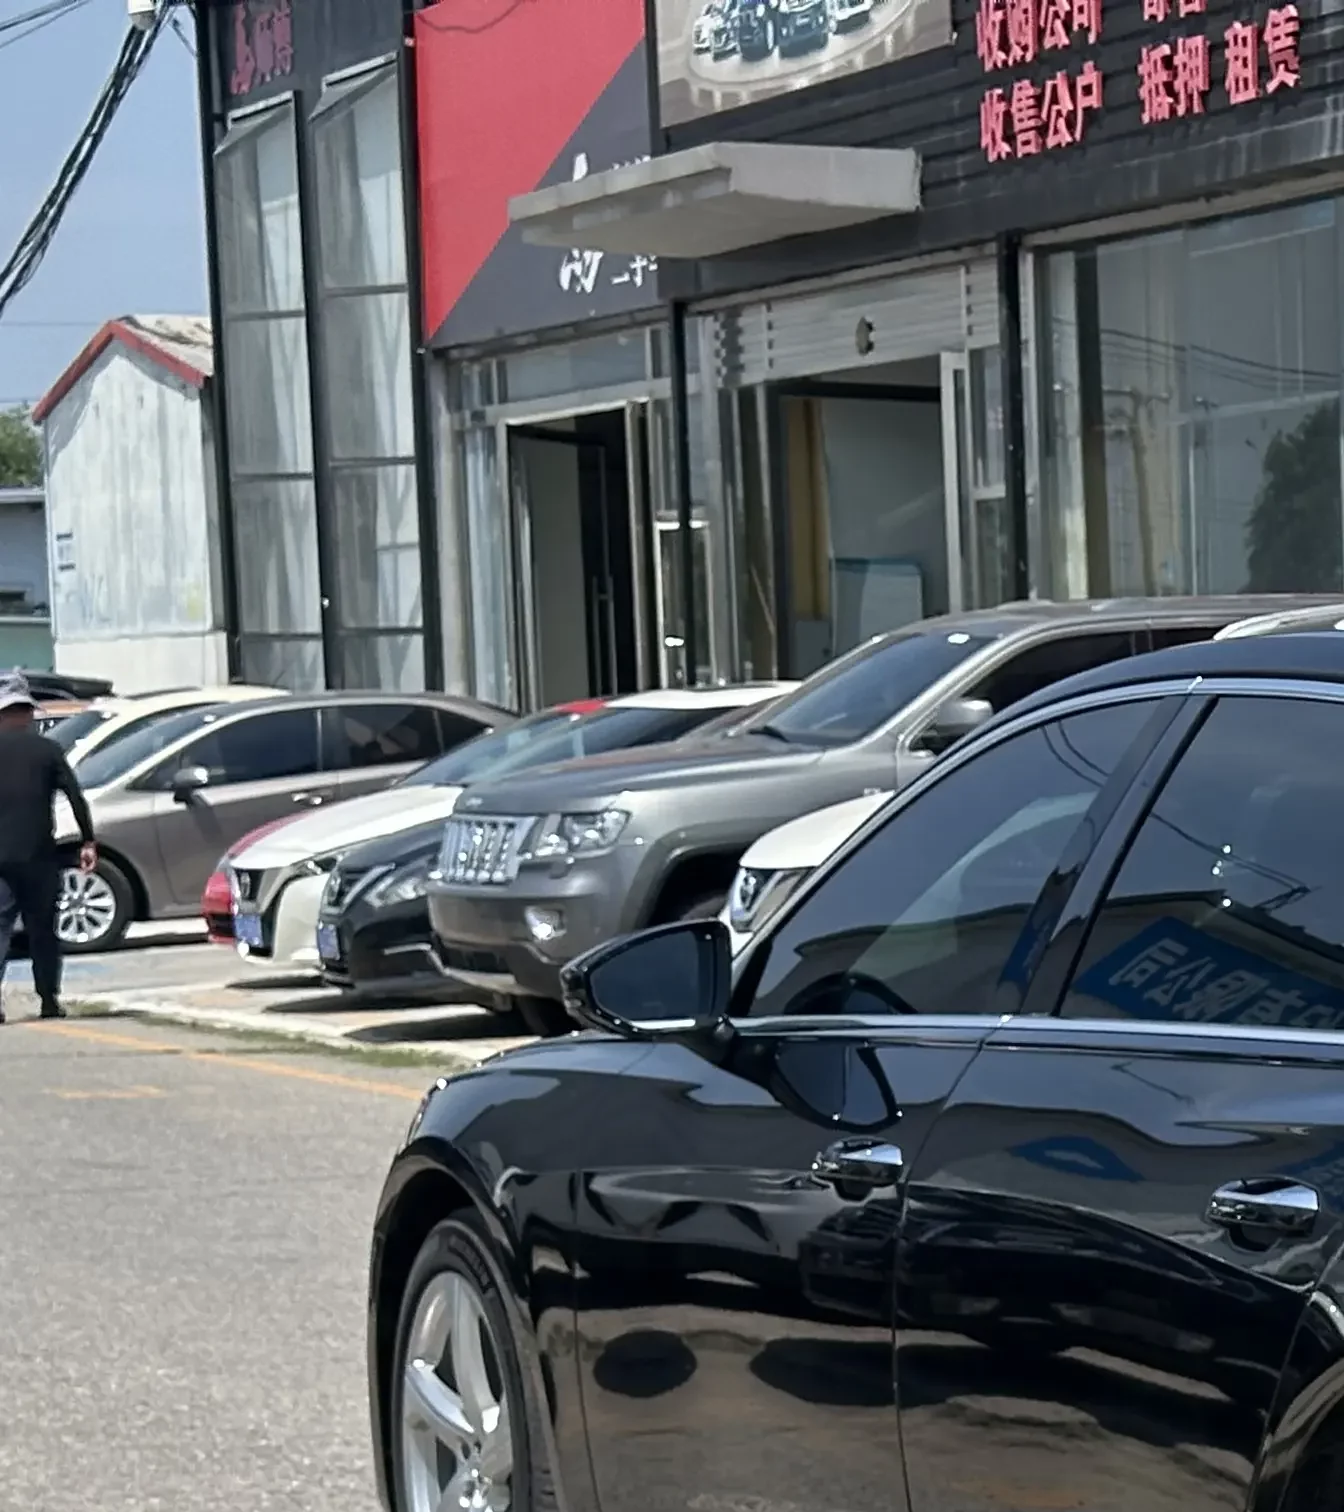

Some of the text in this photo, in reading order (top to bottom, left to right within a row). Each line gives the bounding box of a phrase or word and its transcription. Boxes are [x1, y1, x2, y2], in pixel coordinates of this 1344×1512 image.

[980, 4, 1300, 163] 收售公户 抵押 租赁
